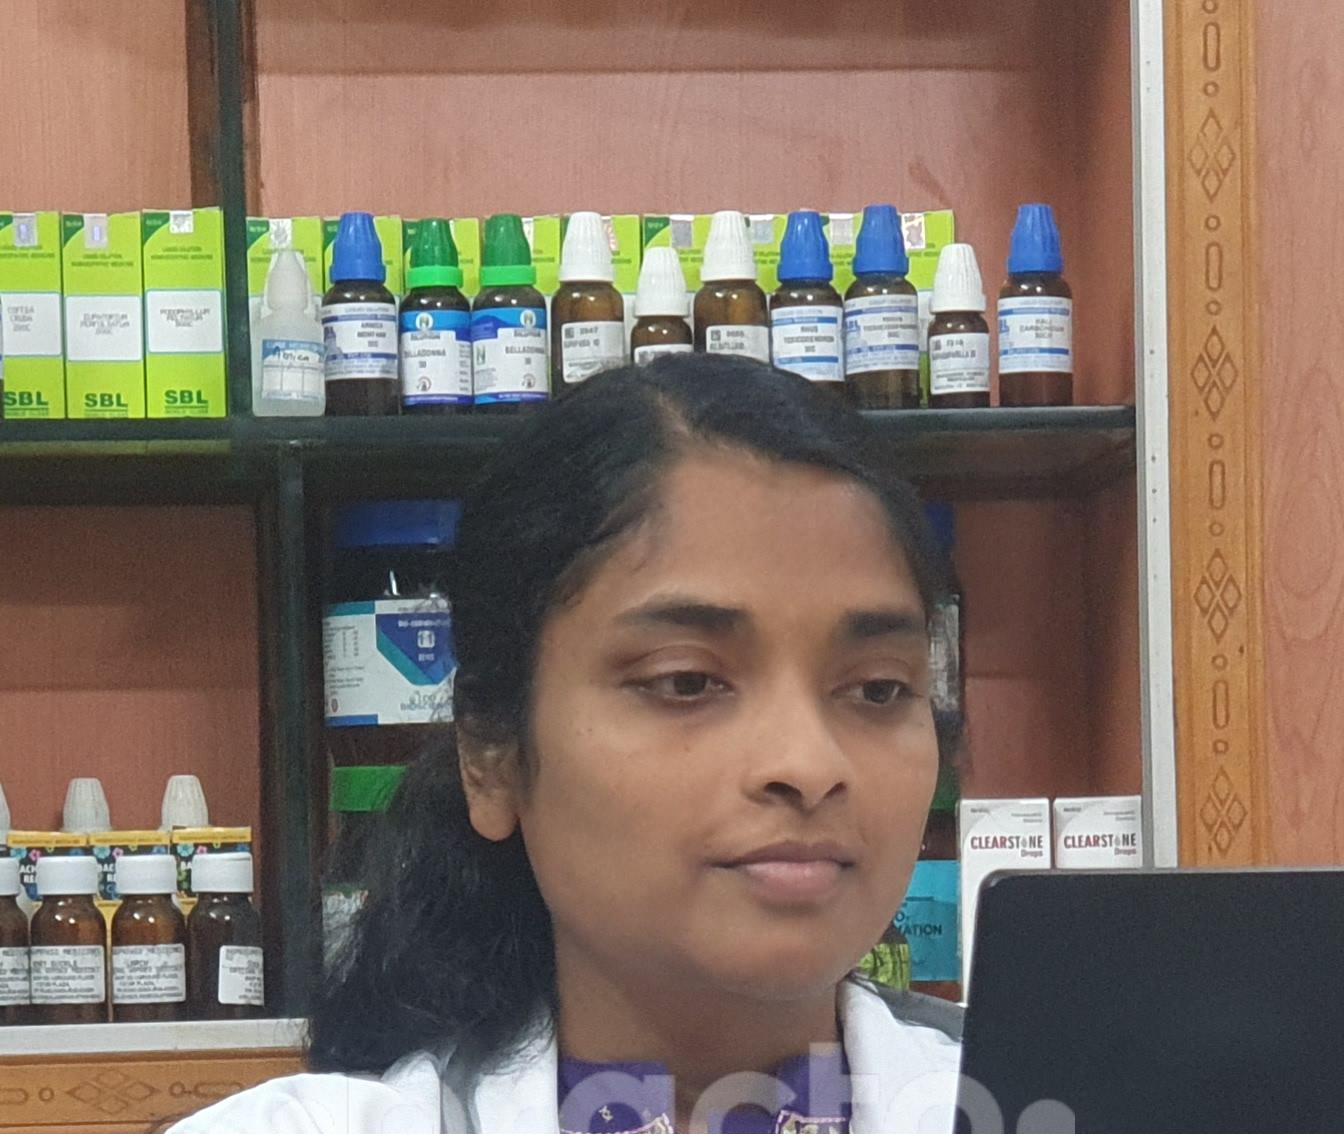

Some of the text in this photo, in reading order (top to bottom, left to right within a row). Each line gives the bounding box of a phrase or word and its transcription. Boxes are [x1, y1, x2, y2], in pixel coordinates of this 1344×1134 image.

[5, 390, 49, 406] SBL
[84, 393, 129, 407] SBL
[163, 389, 209, 405] SBL
